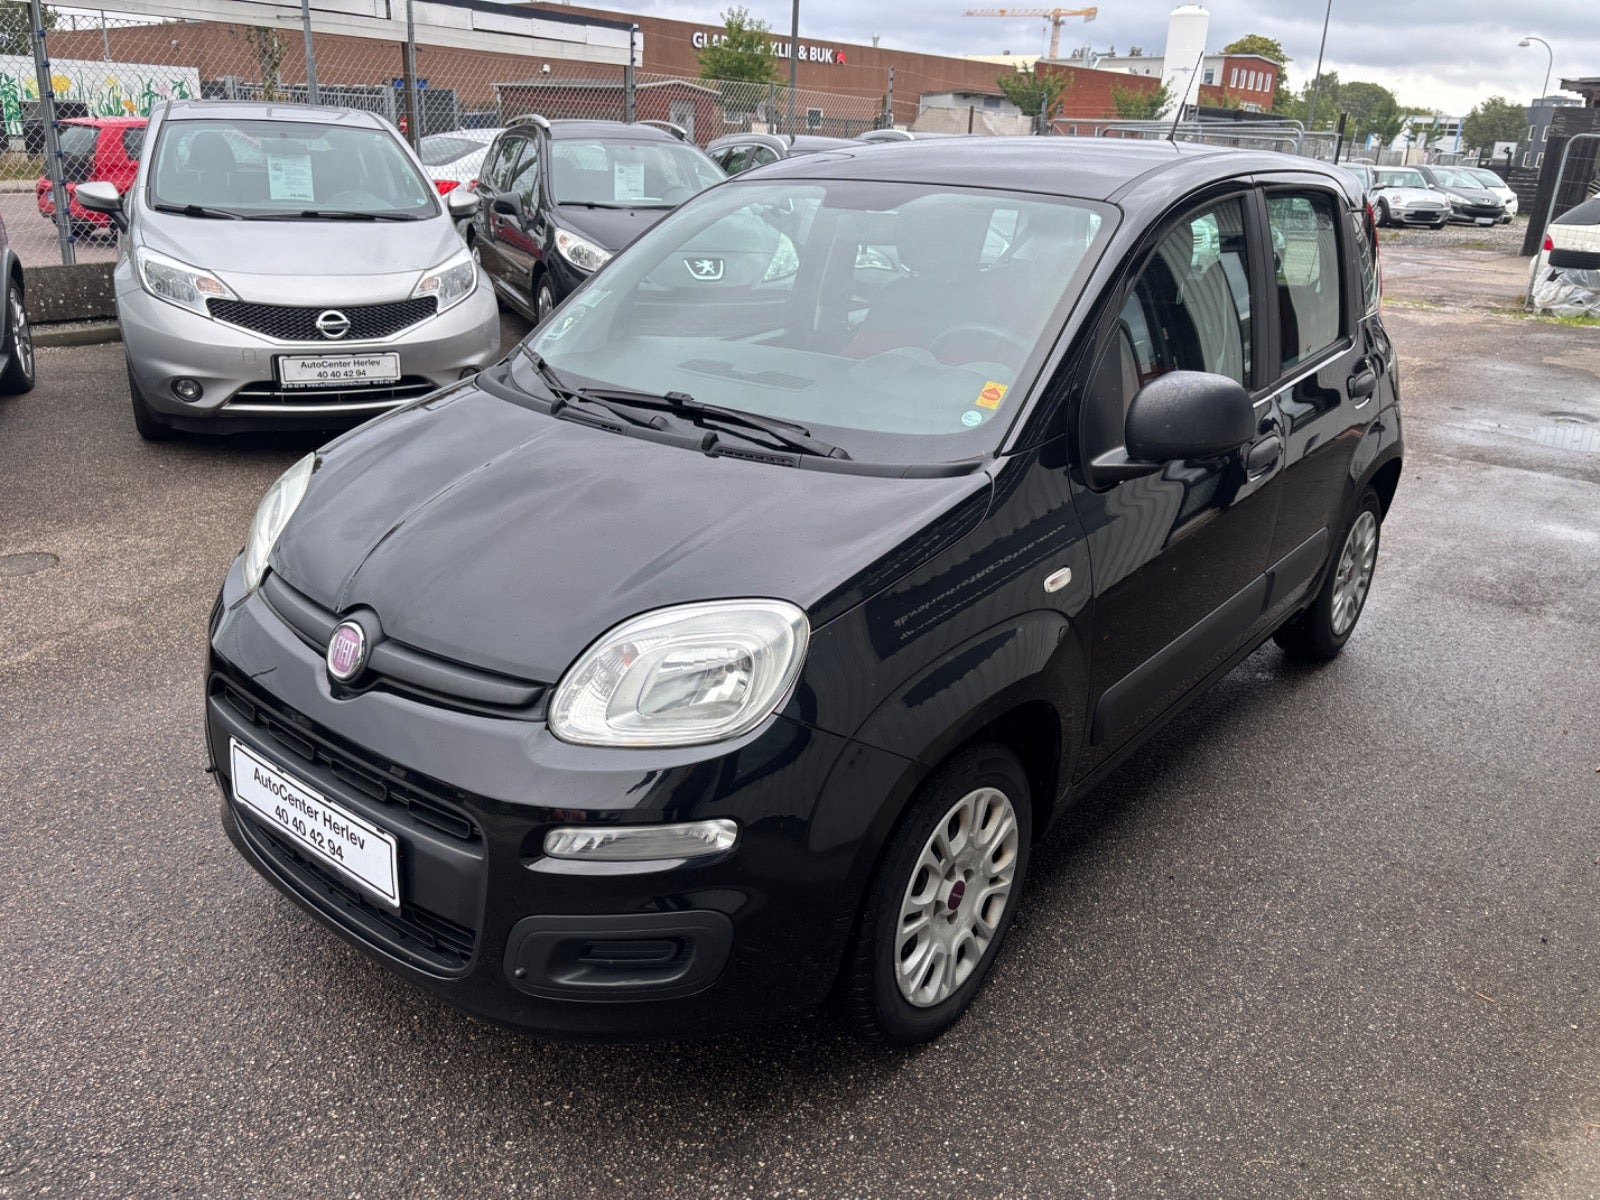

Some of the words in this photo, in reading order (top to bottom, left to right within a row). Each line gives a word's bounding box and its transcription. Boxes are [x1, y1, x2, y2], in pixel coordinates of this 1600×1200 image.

[769, 42, 794, 59] KLI
[798, 45, 807, 60] &
[809, 46, 833, 63] BUK
[300, 360, 351, 369] AutoCenter
[353, 359, 381, 367] Herlev
[317, 371, 328, 379] 40
[355, 369, 367, 377] 94
[333, 635, 357, 667] FIAT
[253, 767, 319, 821] AutoCenter
[323, 811, 365, 850] Herlev
[275, 805, 289, 825] 40
[292, 816, 306, 837] 40
[309, 828, 326, 850] 42
[327, 838, 344, 862] 94
